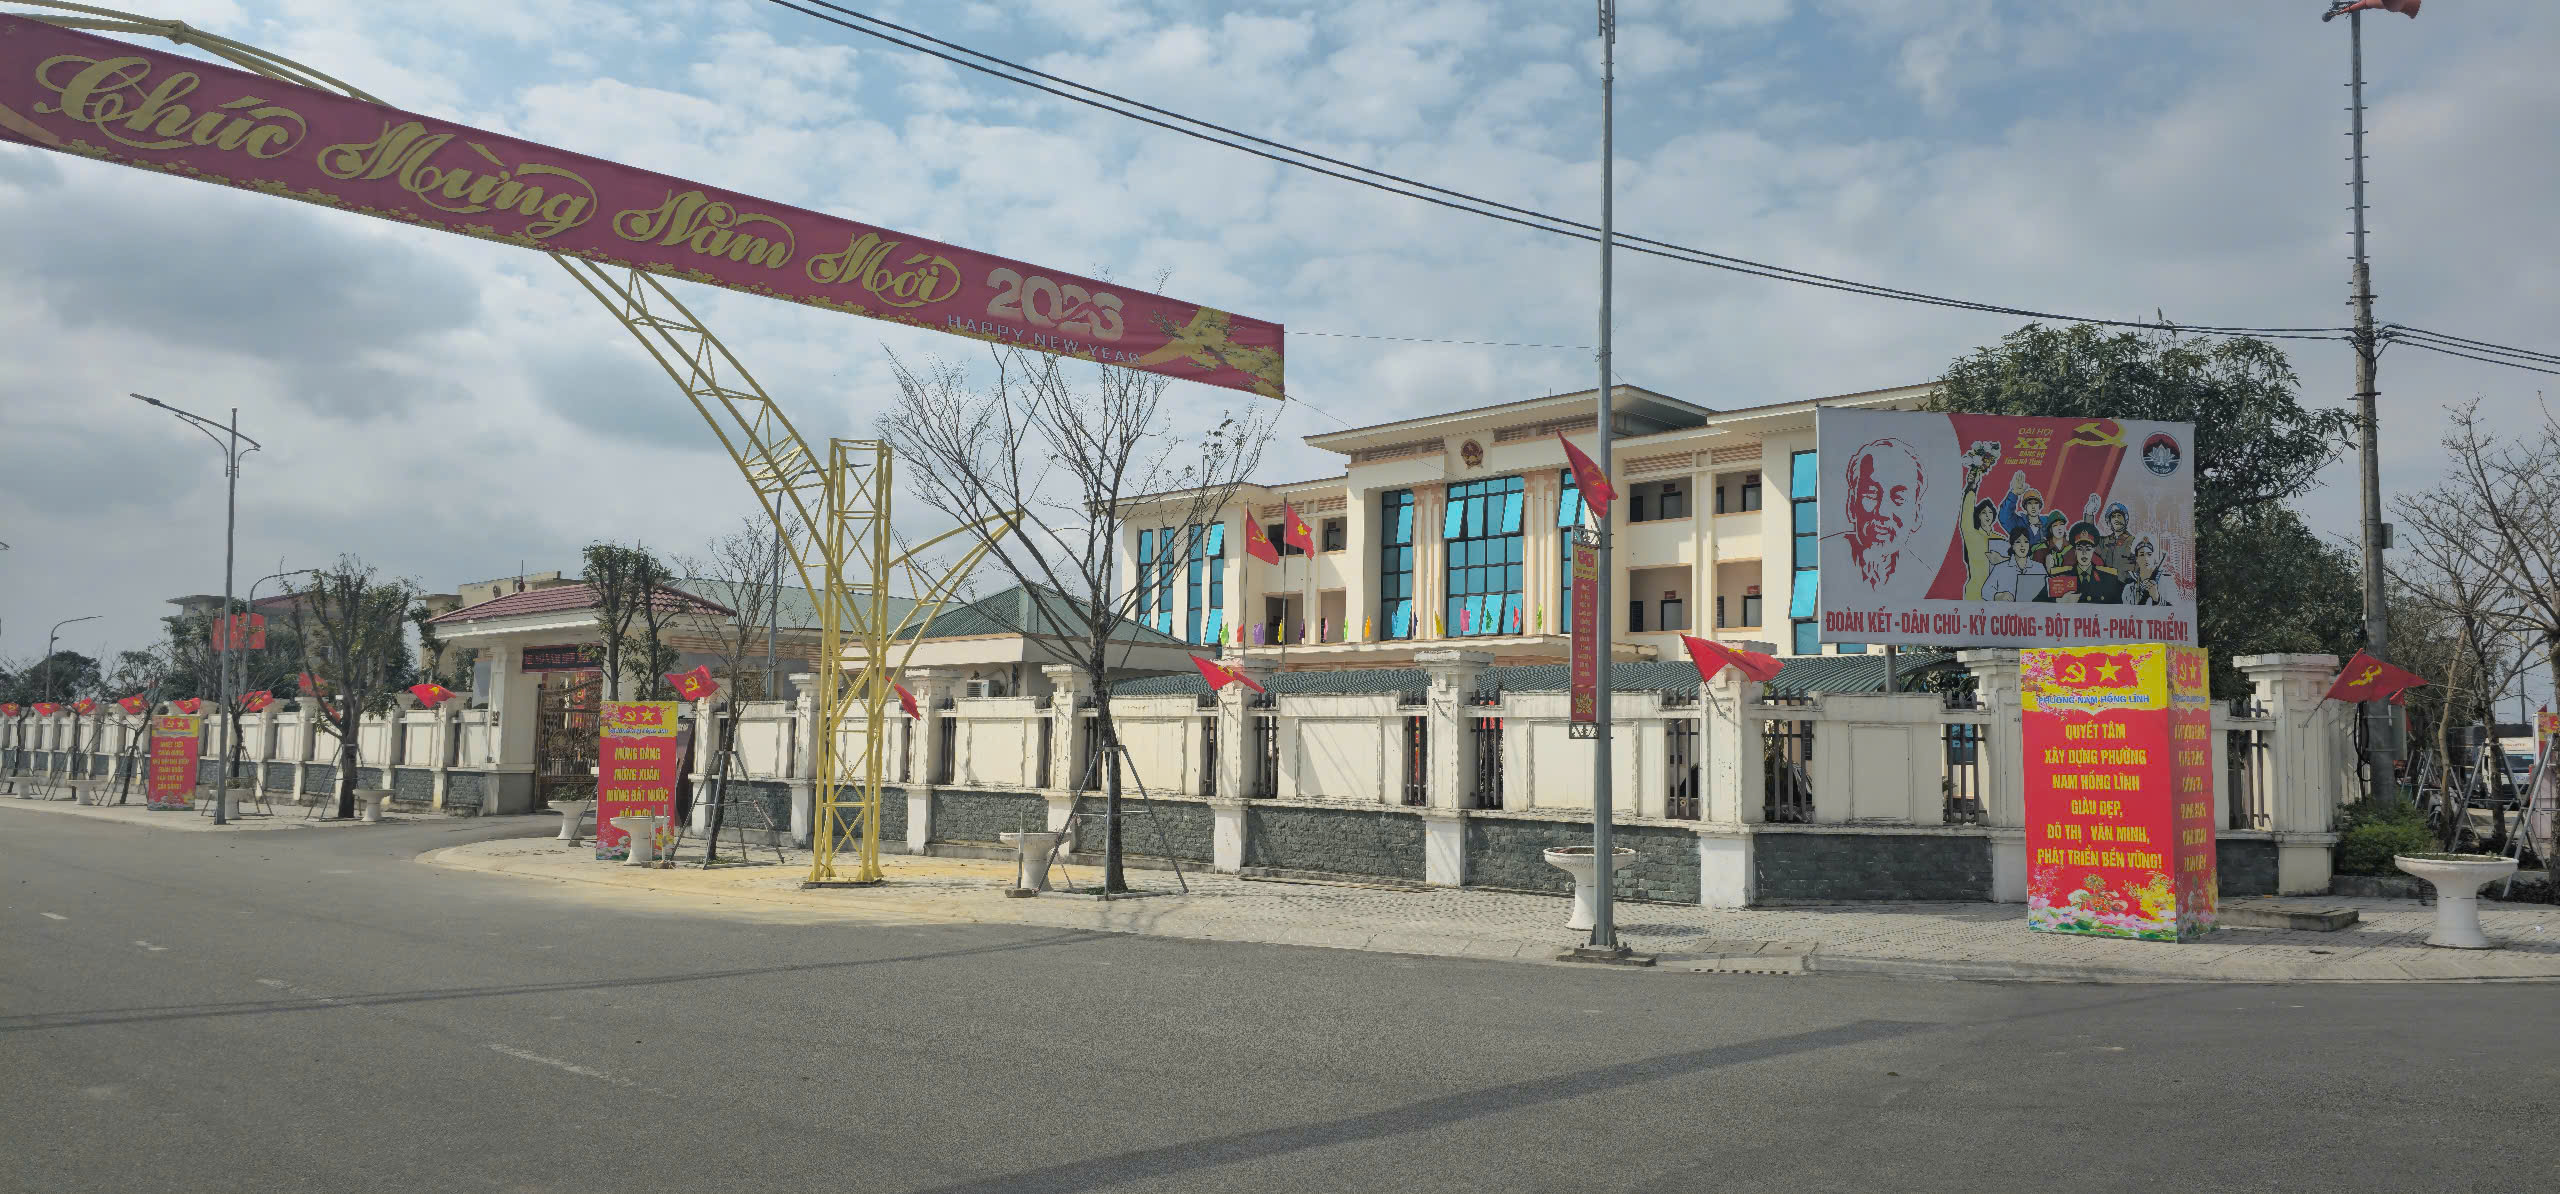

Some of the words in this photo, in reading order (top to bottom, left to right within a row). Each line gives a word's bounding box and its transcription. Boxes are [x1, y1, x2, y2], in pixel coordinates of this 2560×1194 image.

[34, 54, 306, 159] Chúc
[317, 121, 598, 239] Mừng
[612, 190, 795, 268] Năm
[805, 231, 961, 308] Mới
[987, 267, 1125, 342] 2026
[948, 314, 1024, 342] HAPPY
[1034, 332, 1080, 354] NEW
[1087, 343, 1140, 365] YEAR
[2014, 437, 2050, 449] XX
[1826, 606, 1864, 632] ĐOÀN
[1868, 606, 1893, 633] KẾT
[1901, 609, 1930, 634] DÂN
[1933, 608, 1961, 635] CHỦ
[1991, 613, 2037, 637] CƯƠNG
[2045, 613, 2071, 642] ĐỘT
[2074, 614, 2101, 638] PHÁ
[2109, 615, 2144, 639] PHÁT
[2146, 612, 2189, 642] TRIỂN!
[2077, 695, 2098, 704] NAM
[2065, 719, 2098, 740] QUYẾT
[2102, 720, 2126, 739] TÂM
[2044, 746, 2065, 764] XÂY
[2068, 747, 2098, 767] DỰNG
[2100, 745, 2147, 764] PHƯỜNG
[2052, 774, 2078, 789] NAM
[2081, 769, 2112, 790] HỒNG
[2113, 771, 2140, 791] LĨNH
[2071, 796, 2097, 815] GIÀU
[2099, 800, 2123, 819] ĐẸP,
[2047, 821, 2062, 839] ĐÔ
[2064, 824, 2082, 843] THỊ
[2090, 822, 2114, 841] VĂN
[2116, 826, 2150, 844] MINH,
[2037, 846, 2065, 865] PHÁT
[2067, 844, 2100, 867] TRIỂN
[2102, 847, 2125, 868] BỀN
[2127, 849, 2162, 869] VỮNG!
